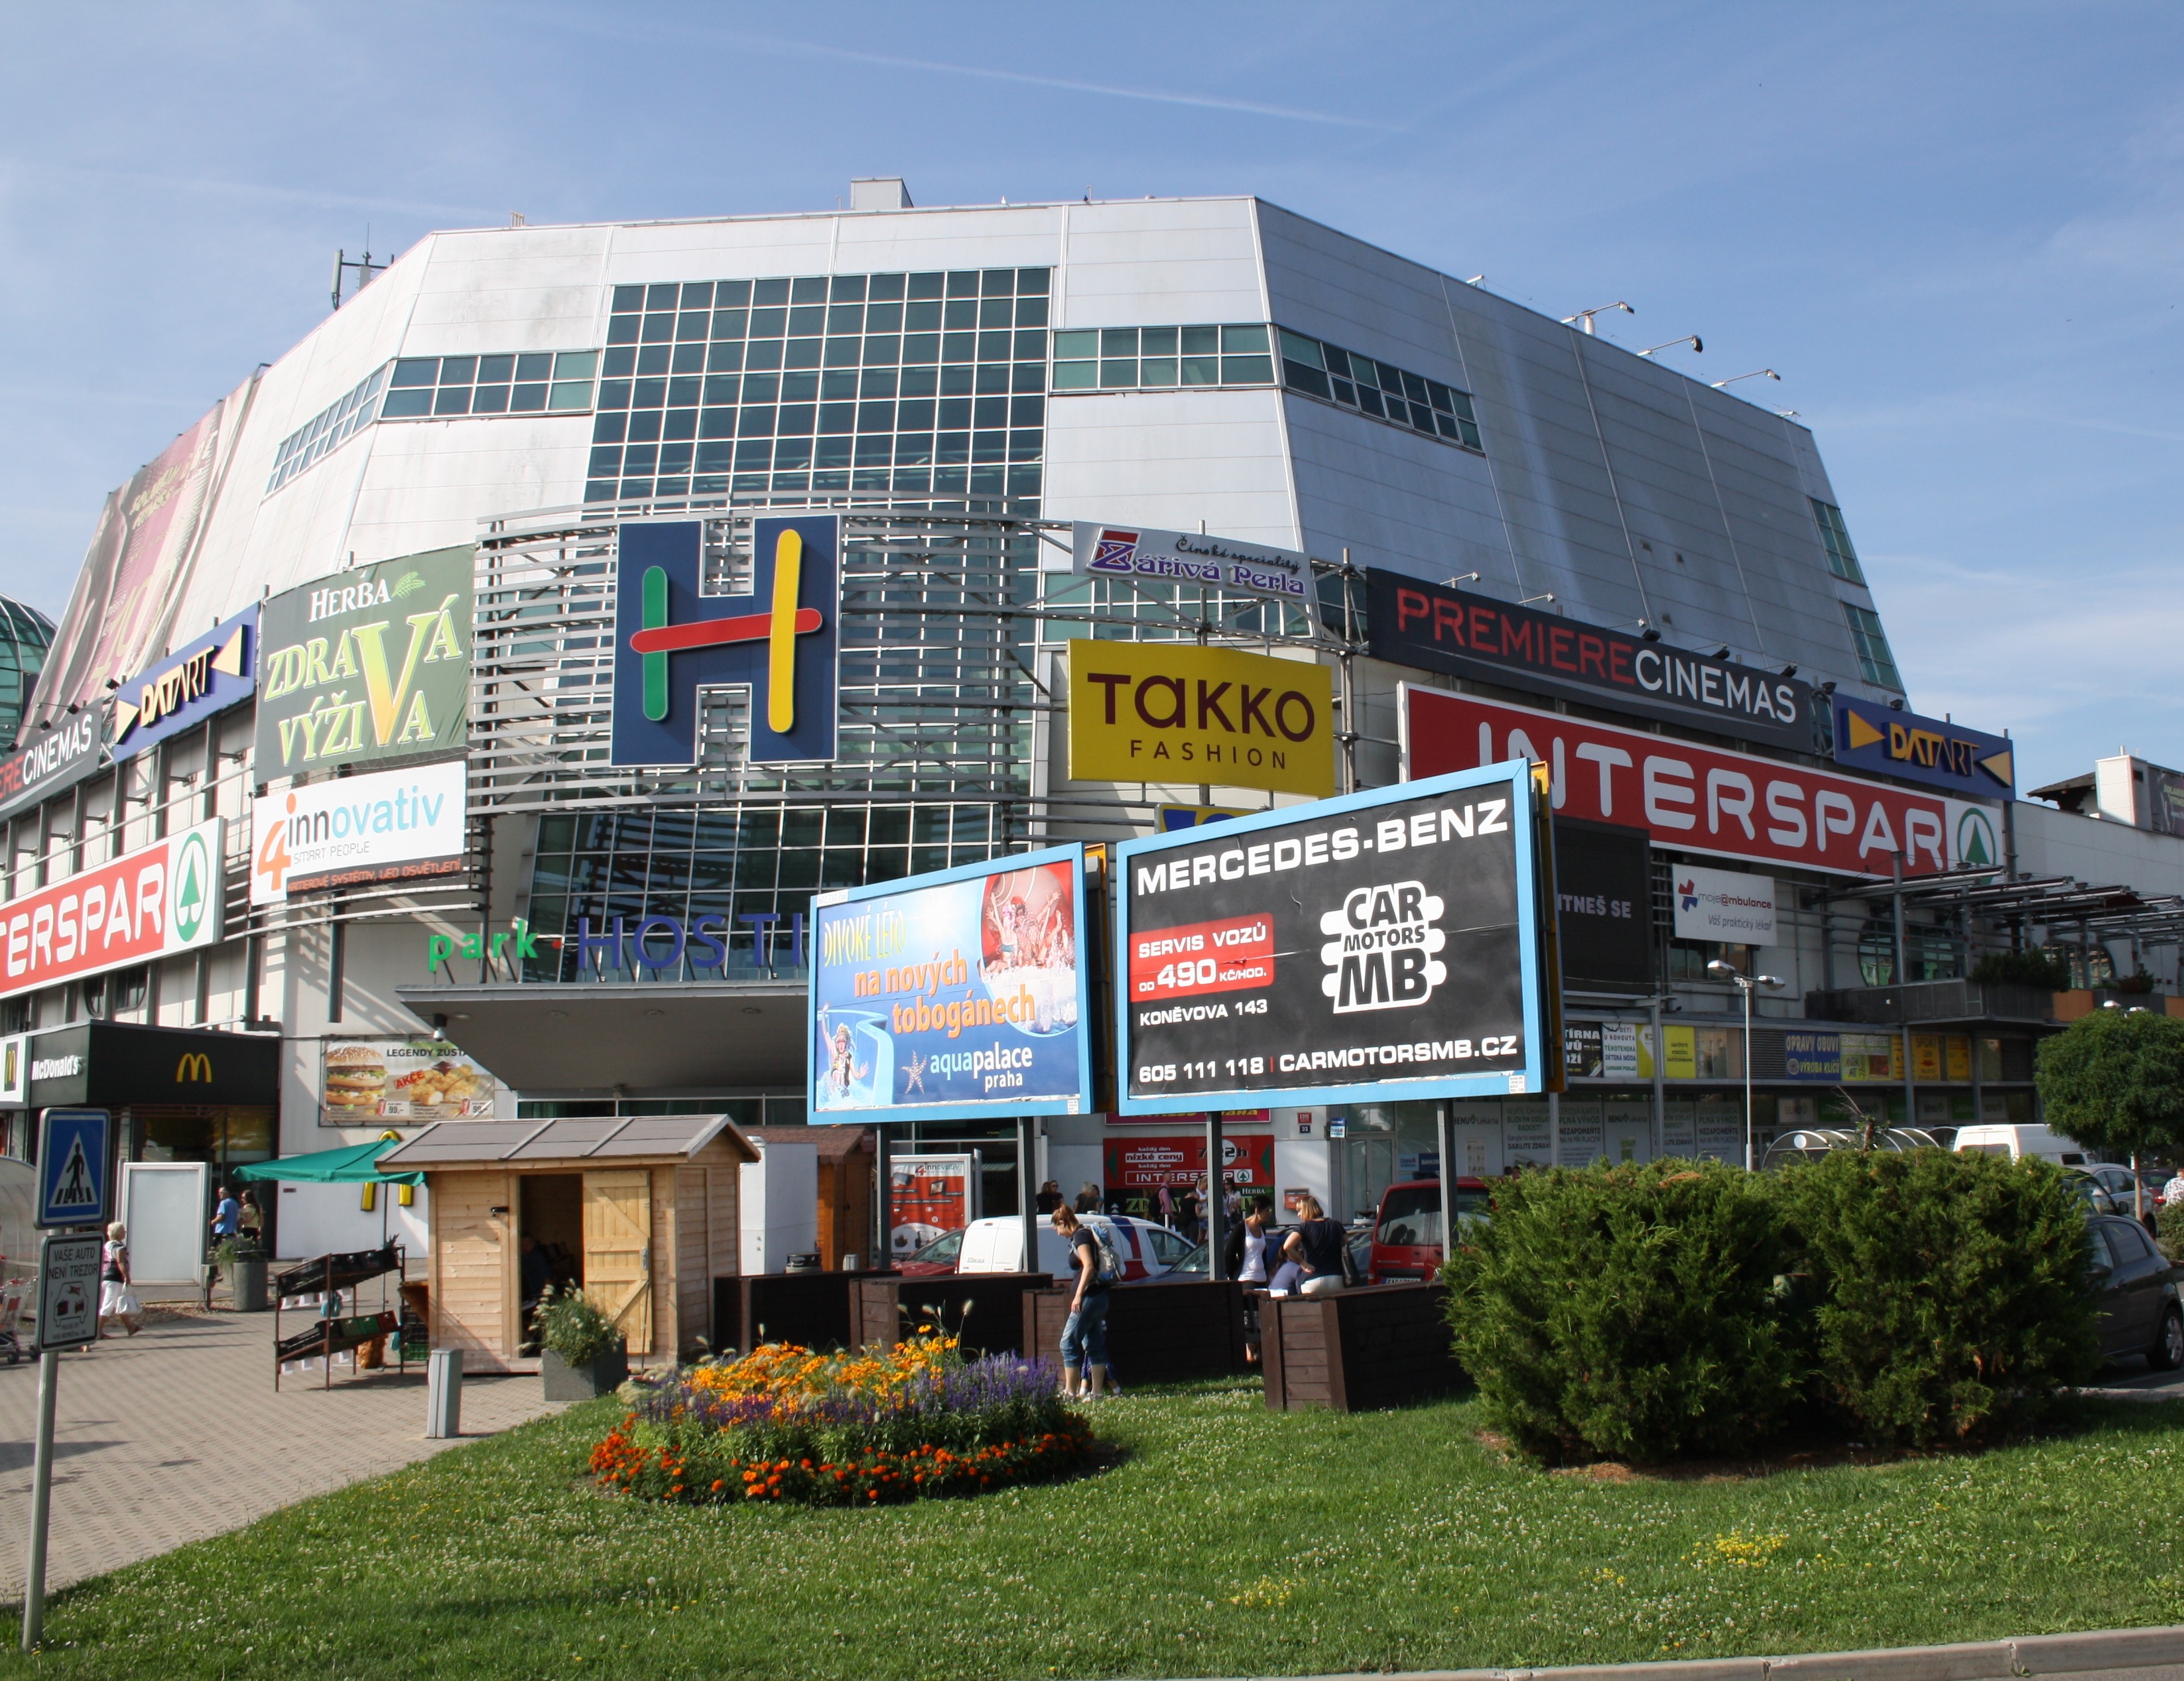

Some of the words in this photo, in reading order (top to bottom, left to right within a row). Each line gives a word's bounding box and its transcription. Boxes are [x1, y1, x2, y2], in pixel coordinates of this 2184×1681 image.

[1086, 527, 1222, 582] Zářivá
[1229, 562, 1307, 597] Perla
[1176, 534, 1230, 558] Čínské
[1231, 550, 1301, 575] speciality
[139, 645, 216, 728] DATART
[264, 594, 463, 747] ZDRAVÁ
[1130, 739, 1286, 770] FASHION
[1889, 722, 1981, 777] DATART
[294, 847, 326, 865] SMART
[330, 841, 371, 857] PEOPLE
[1137, 798, 1509, 896] MERCEDES-BENZ
[379, 867, 399, 879] LED
[1346, 887, 1425, 930] CAR
[1610, 899, 1632, 918] SE
[1699, 893, 1772, 909] moje@mbulance
[824, 904, 871, 967] DIVOKÉ
[875, 901, 905, 960] LÉTO
[1138, 935, 1204, 959] SERVIS
[1212, 921, 1267, 948] VOZŮ
[1344, 924, 1426, 953] MOTORS
[1708, 914, 1720, 926] Váš
[1722, 916, 1754, 932] praktický
[1755, 918, 1772, 930] lékař
[428, 919, 539, 973] park
[577, 912, 803, 970] HOSTI
[855, 971, 881, 997] na
[885, 948, 968, 997] nových
[1139, 980, 1155, 992] OD
[1157, 958, 1217, 989] 490
[1219, 965, 1267, 983] KČ/HOD.
[1337, 947, 1428, 1009] MB
[892, 984, 1035, 1038] tobogánech
[1139, 1002, 1228, 1027] KONĚVOVA
[1235, 999, 1268, 1017] 143
[387, 1048, 433, 1057] LEGENDY
[1279, 1036, 1517, 1074] CARMOTORSMB.CZ
[1786, 1035, 1815, 1052] OPRAVY
[1817, 1036, 1839, 1052] OBUVI
[31, 1054, 81, 1080] McDonald's
[930, 1042, 1033, 1081] aquapalace
[1139, 1063, 1177, 1084] 605
[1183, 1060, 1217, 1081] 111
[1225, 1057, 1264, 1077] 118
[396, 1069, 424, 1090] AKCE
[984, 1070, 1023, 1092] praha
[54, 1246, 74, 1261] VAŠE
[75, 1246, 96, 1260] AUTO
[70, 1263, 99, 1277] TREZOR
